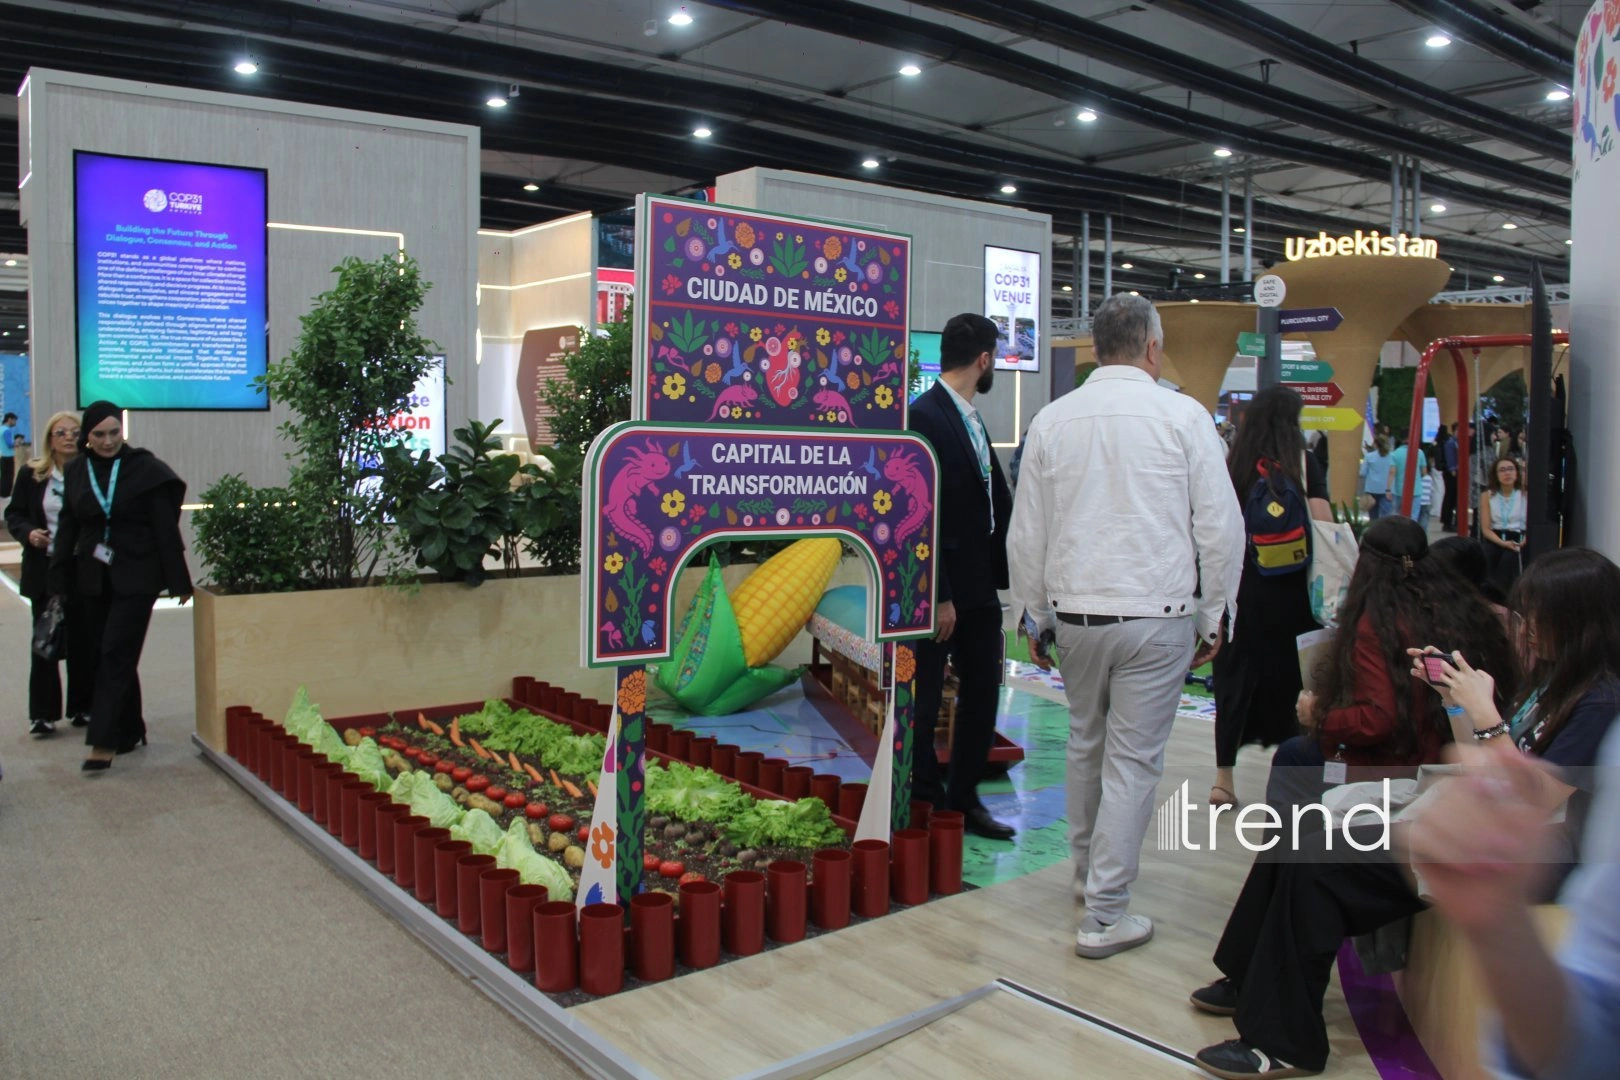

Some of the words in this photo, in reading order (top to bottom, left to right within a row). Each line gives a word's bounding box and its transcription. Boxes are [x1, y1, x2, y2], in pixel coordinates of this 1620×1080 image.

[169, 192, 202, 204] COP31
[116, 224, 150, 235] Building
[167, 228, 193, 237] Future
[195, 230, 228, 240] Through
[195, 239, 210, 248] and
[211, 240, 237, 250] Action
[1285, 230, 1439, 262] Uzbekistan
[994, 273, 1030, 288] COP31
[687, 277, 768, 306] CIUDAD
[773, 286, 800, 309] DE
[804, 288, 878, 317] MÉXICO
[993, 289, 1032, 304] VENUE
[1280, 316, 1317, 324] PLURICULTURAL
[712, 442, 796, 464] CAPITAL
[800, 446, 824, 465] DE
[828, 446, 852, 465] LA
[688, 471, 867, 495] TRANSFORMACIÓN
